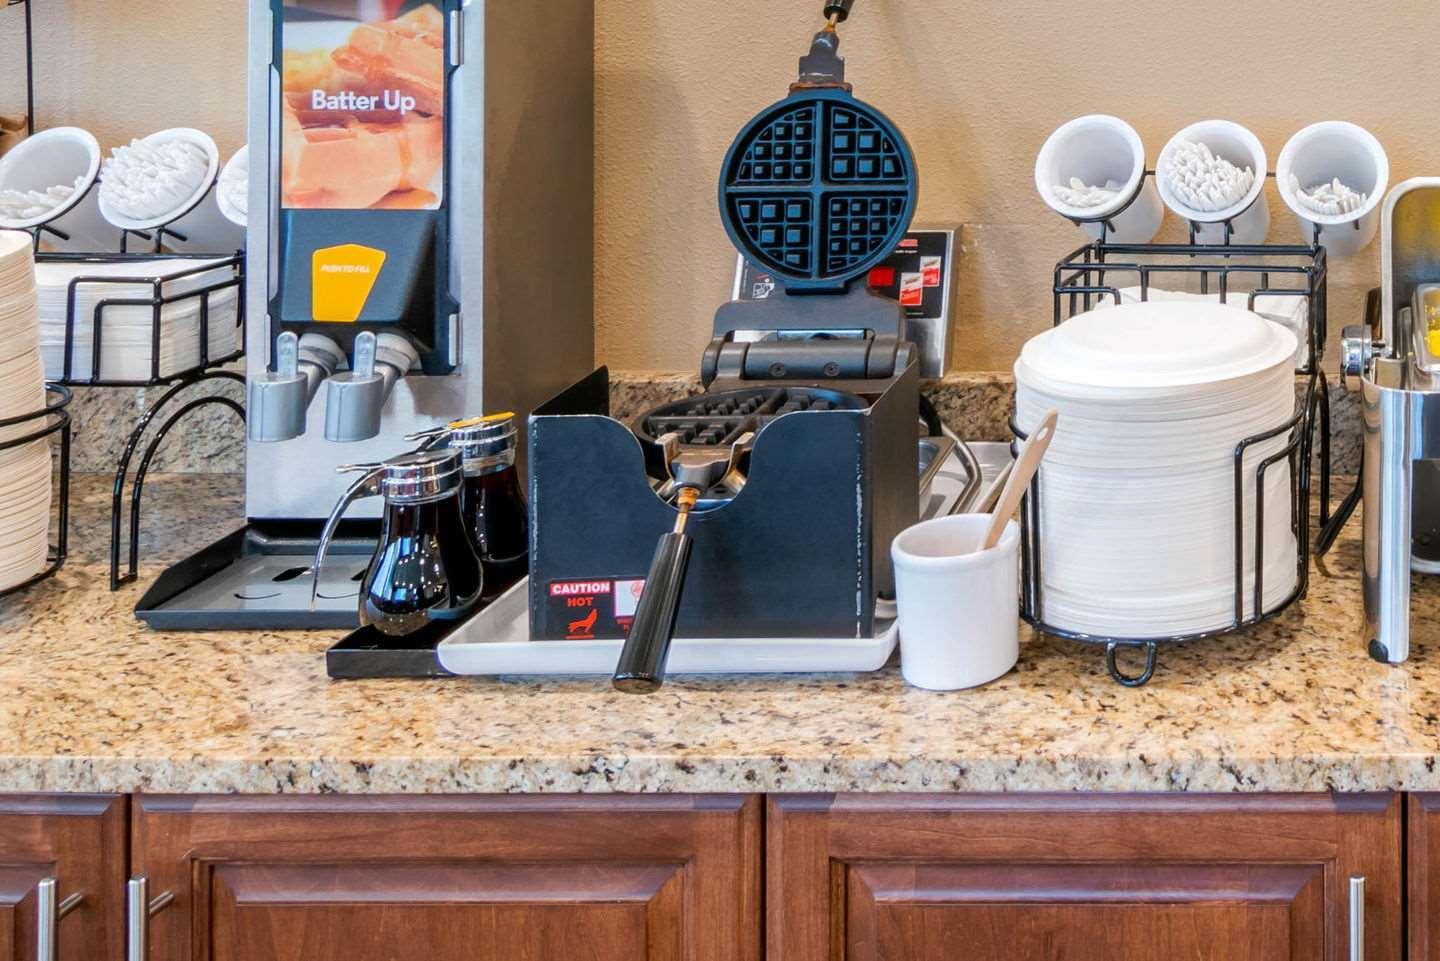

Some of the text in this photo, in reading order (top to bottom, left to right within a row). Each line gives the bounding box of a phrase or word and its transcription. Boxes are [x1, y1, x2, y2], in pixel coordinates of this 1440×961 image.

[312, 89, 416, 115] Batter Up
[553, 583, 610, 594] CAUTION
[567, 597, 594, 607] HOT
